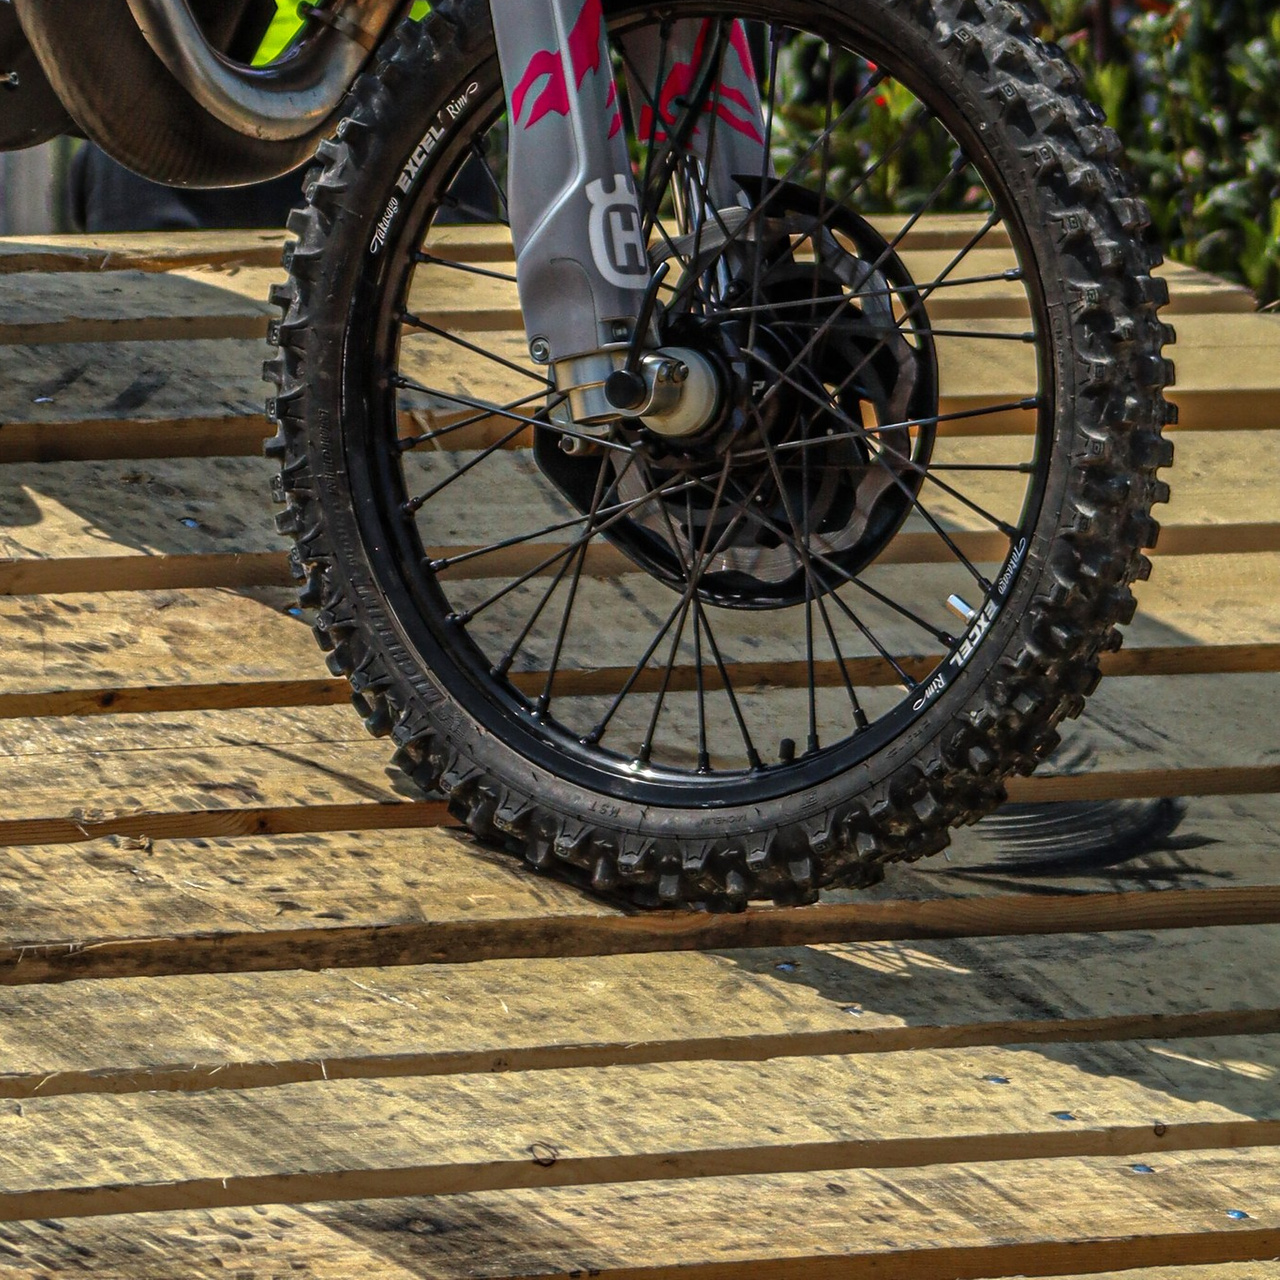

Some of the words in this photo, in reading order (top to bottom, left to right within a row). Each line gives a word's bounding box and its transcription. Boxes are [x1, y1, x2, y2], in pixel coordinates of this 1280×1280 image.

[370, 196, 399, 255] Takasago
[395, 125, 446, 194] EXCEL
[446, 81, 479, 120] Rim
[998, 537, 1027, 595] Takasago
[949, 598, 1000, 667] EXCEL
[912, 672, 946, 712] Rim
